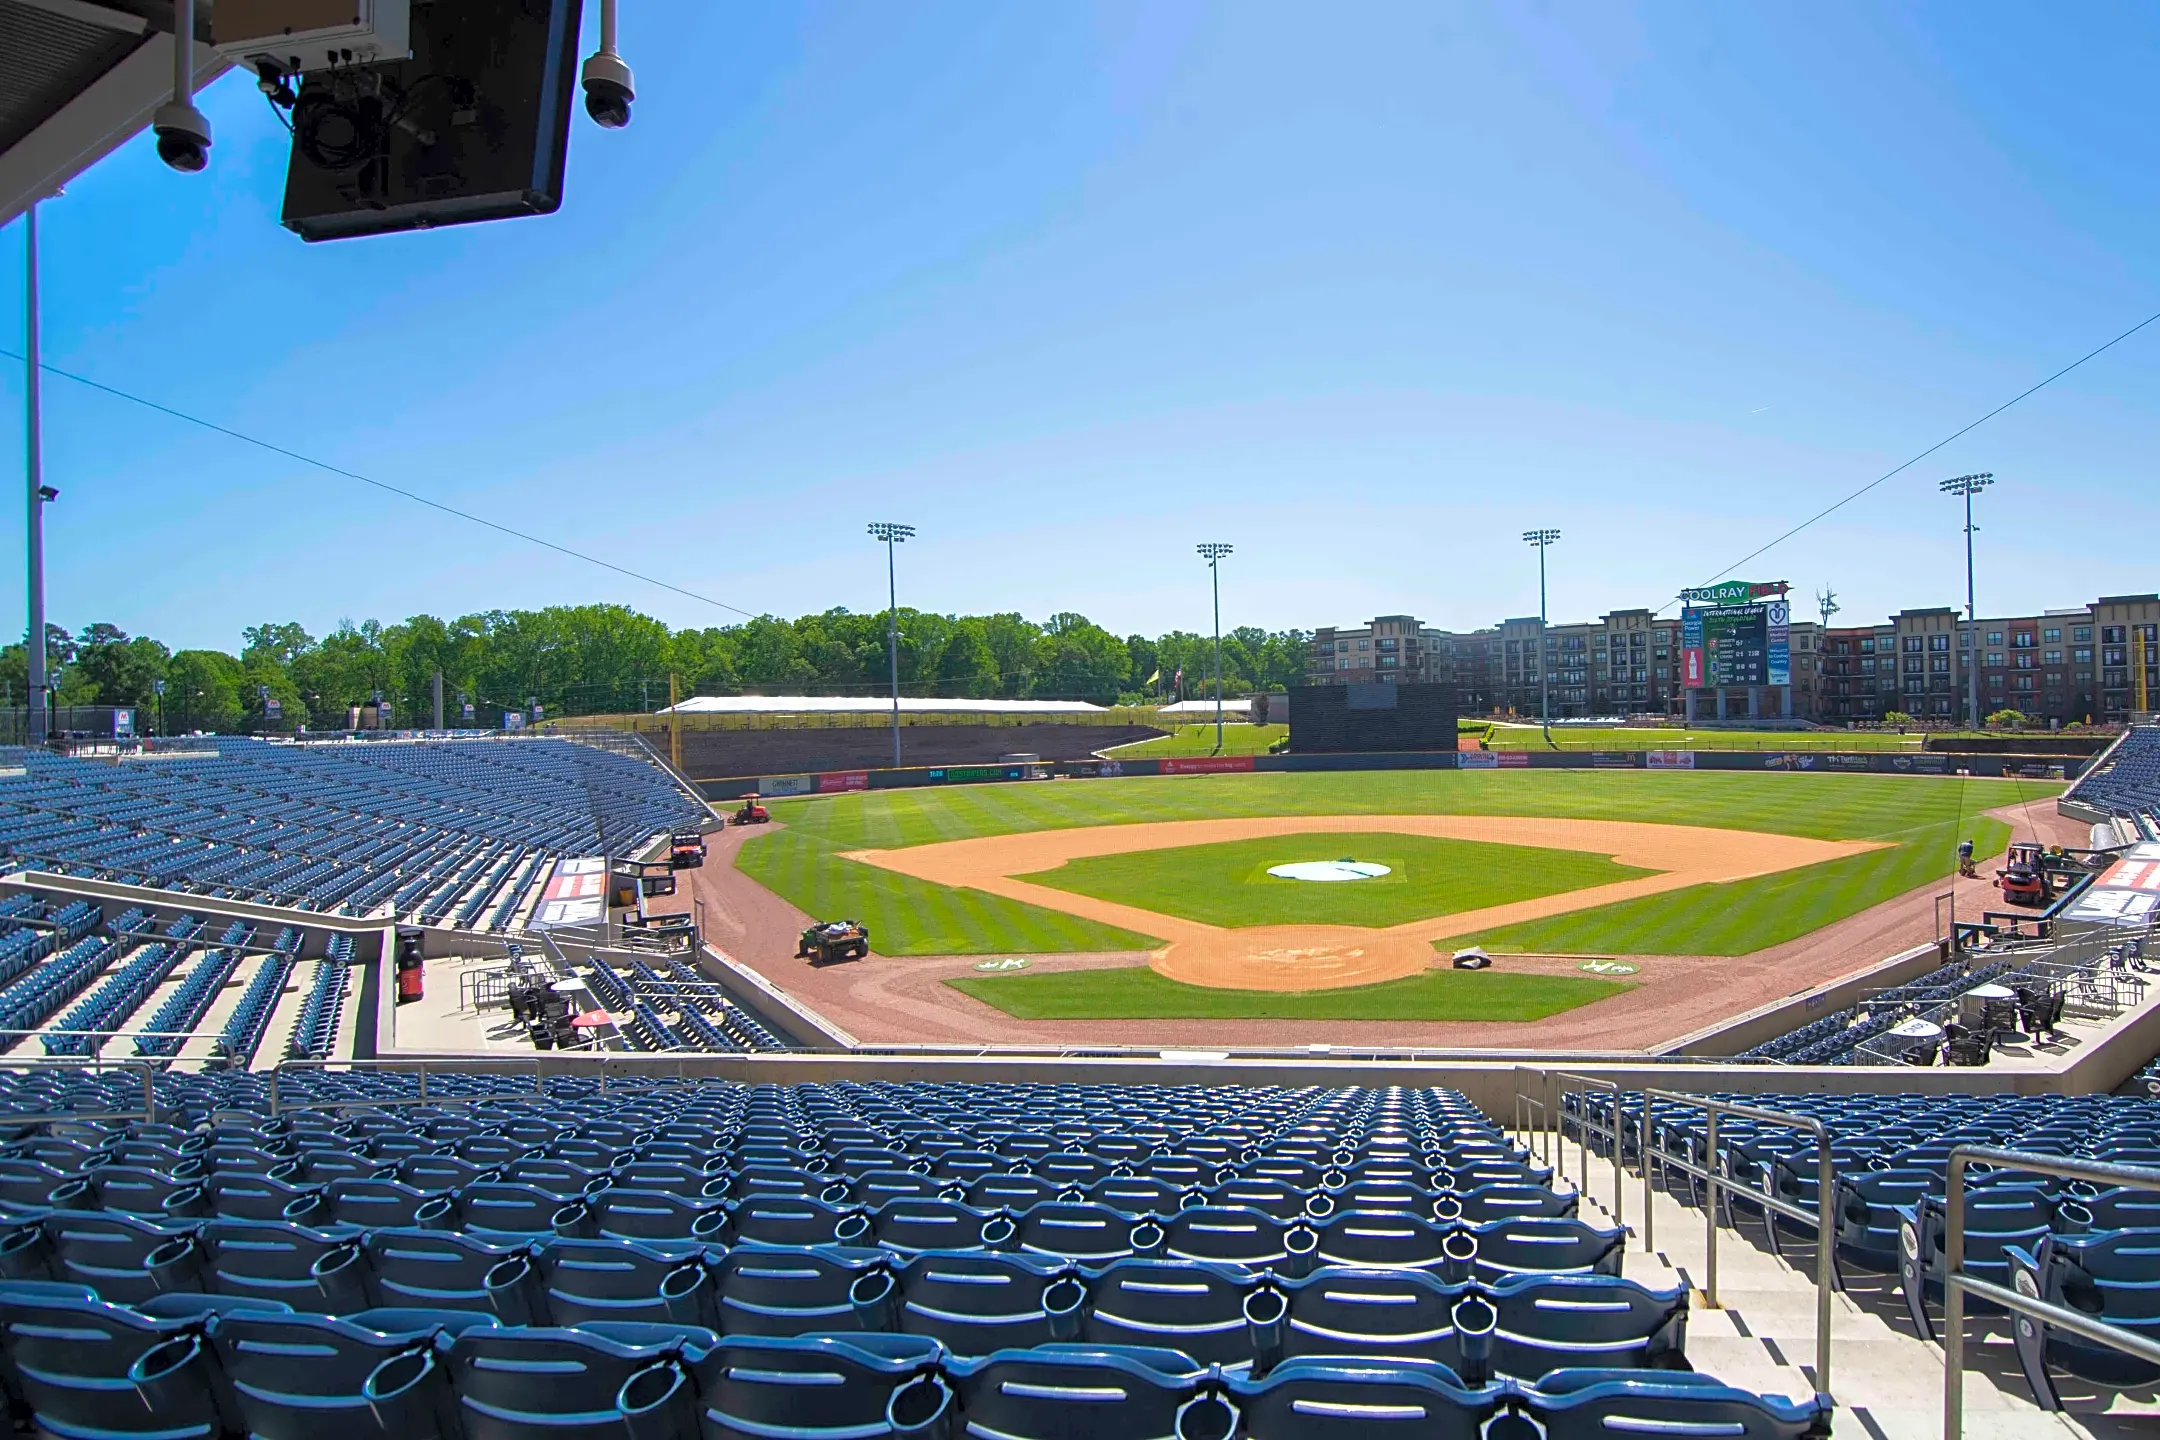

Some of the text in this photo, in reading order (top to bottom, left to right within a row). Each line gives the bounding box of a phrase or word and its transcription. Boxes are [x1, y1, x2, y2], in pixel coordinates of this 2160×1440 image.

[1679, 583, 1789, 601] COOLRAY FIELD
[1703, 608, 1743, 617] INTERNATIONAL
